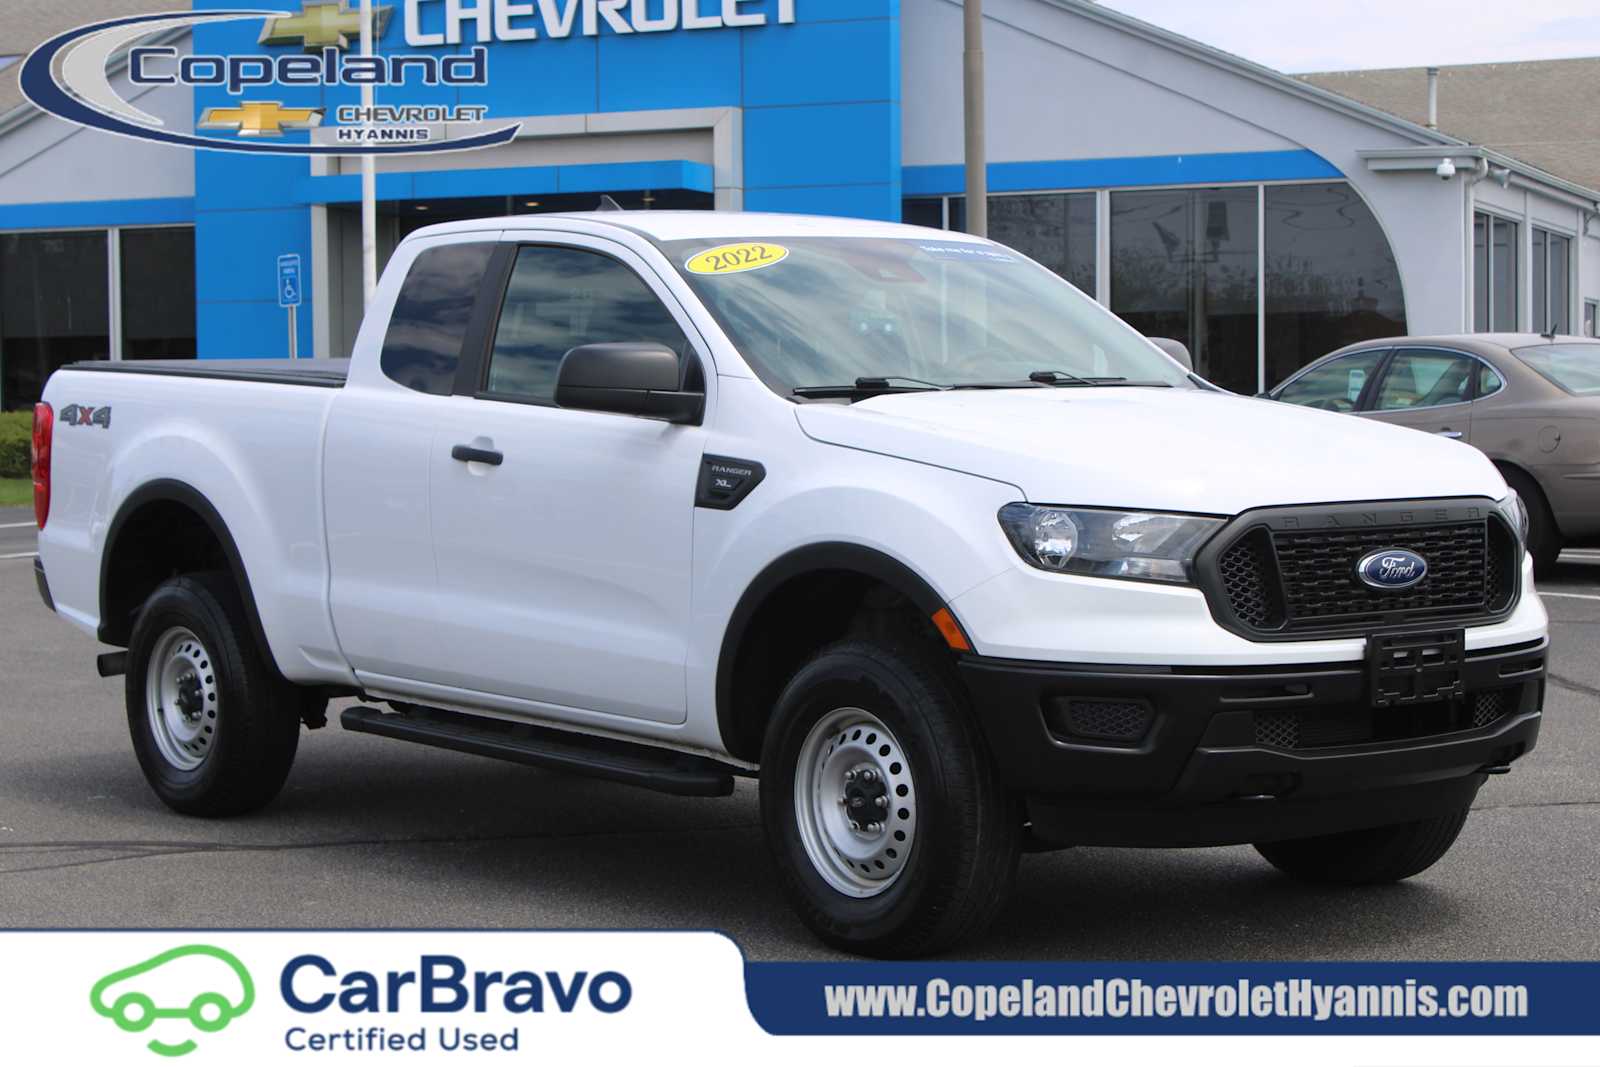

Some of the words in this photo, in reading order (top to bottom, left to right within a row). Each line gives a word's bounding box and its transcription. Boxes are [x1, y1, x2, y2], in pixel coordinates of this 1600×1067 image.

[705, 246, 773, 272] 2022
[711, 464, 752, 476] RANGER
[1283, 508, 1481, 528] RANGER
[1379, 556, 1416, 580] Ford
